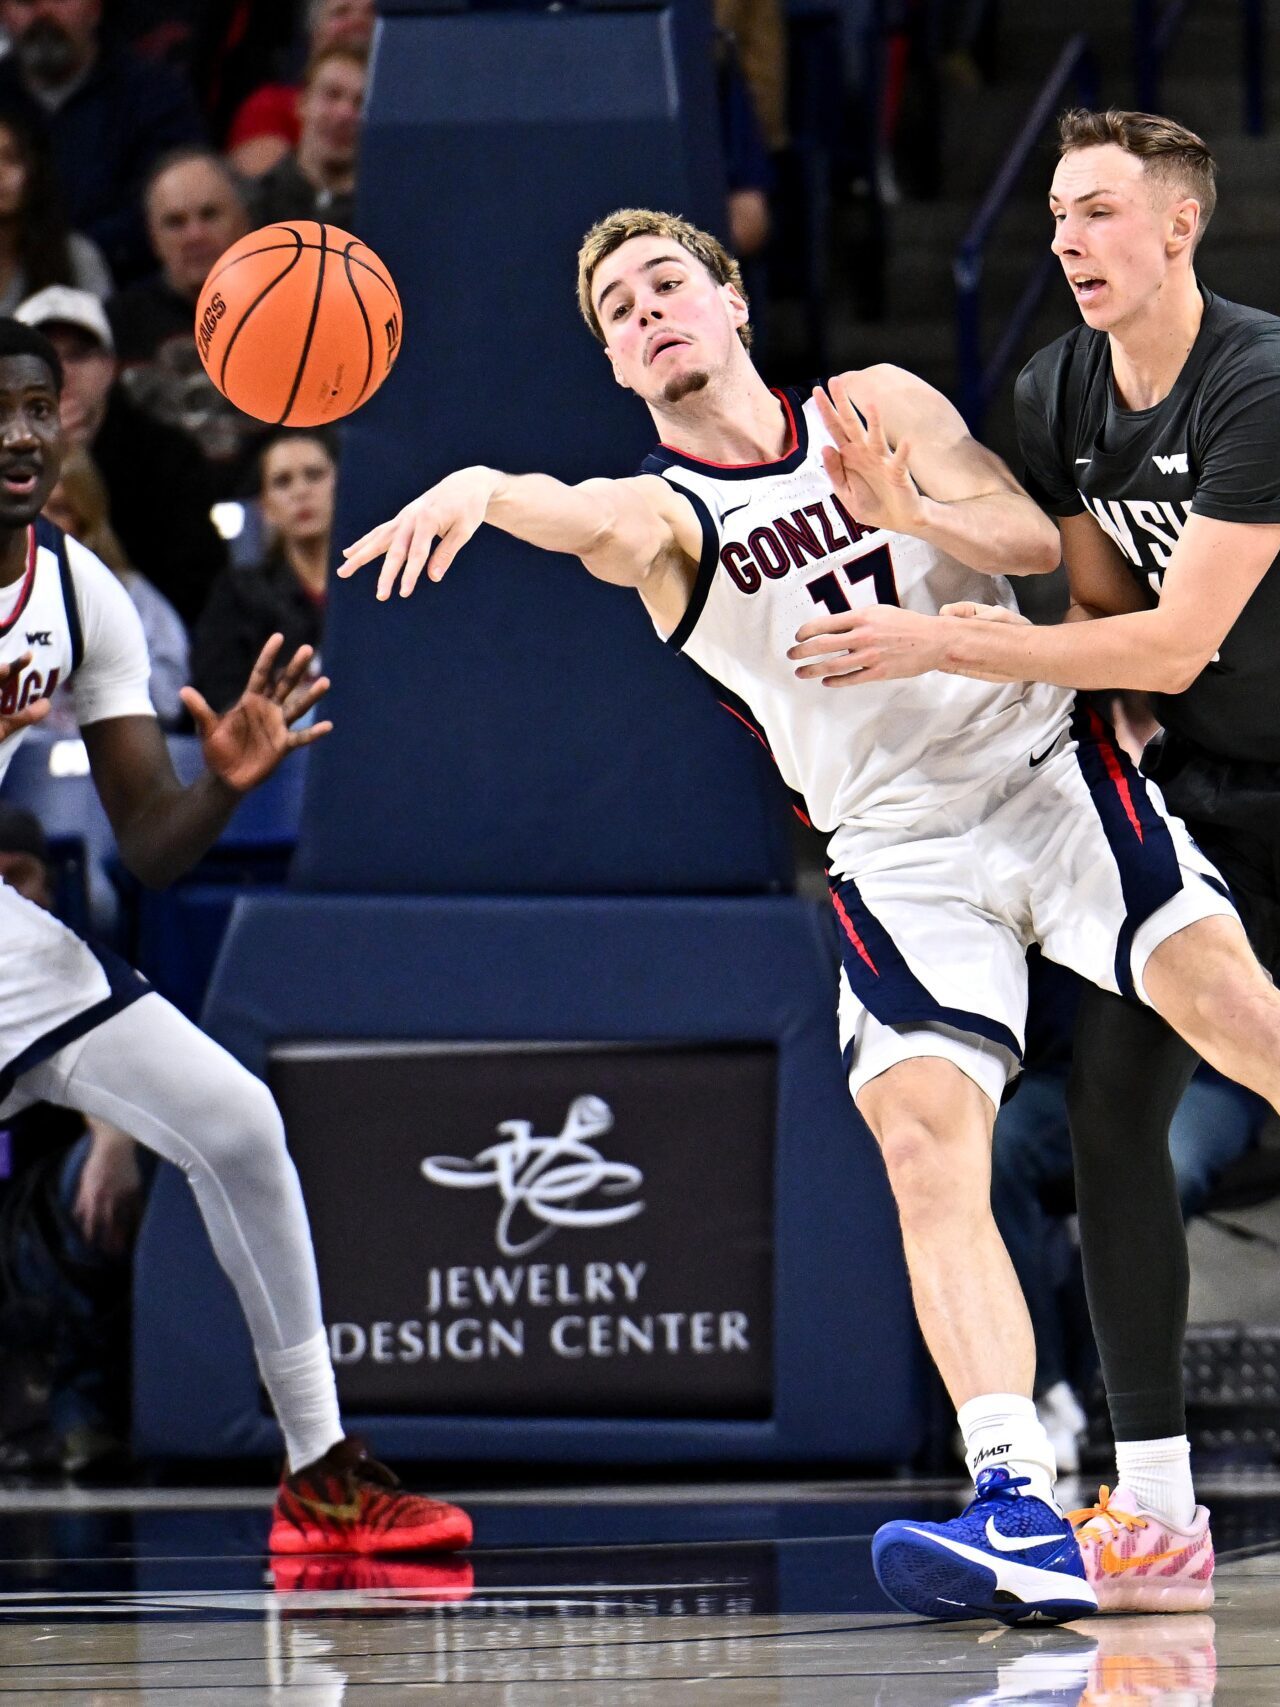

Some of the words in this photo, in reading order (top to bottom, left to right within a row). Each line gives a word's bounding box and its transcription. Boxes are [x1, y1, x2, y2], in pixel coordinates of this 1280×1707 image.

[427, 1260, 648, 1314] JEWELRY
[330, 1317, 525, 1365] DESIGN
[549, 1310, 751, 1360] CENTER
